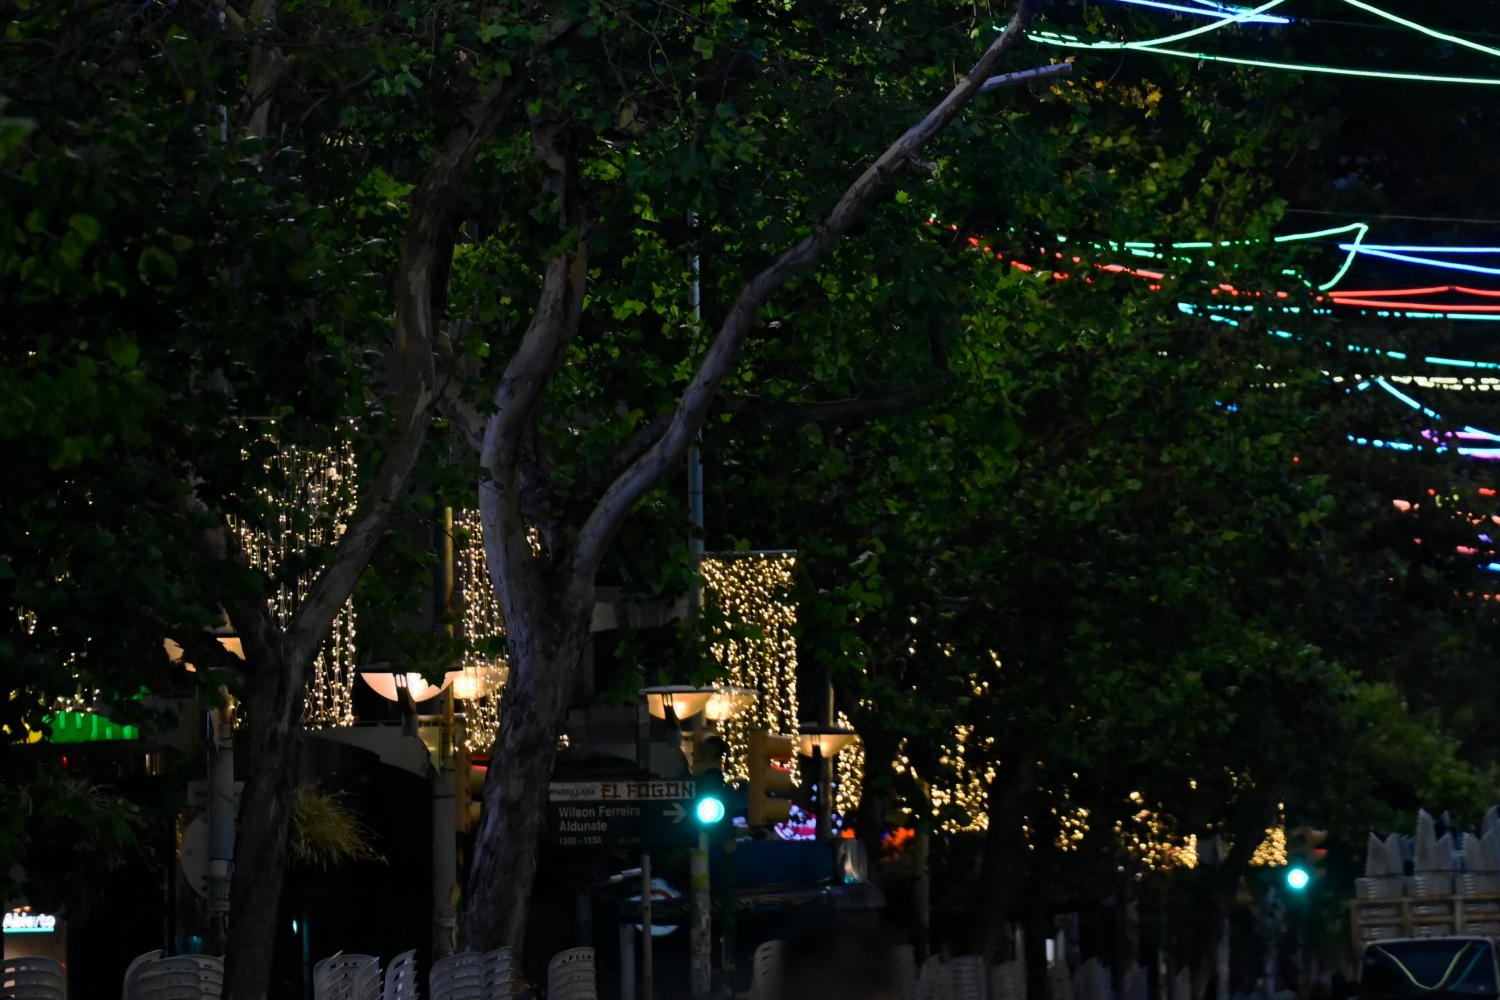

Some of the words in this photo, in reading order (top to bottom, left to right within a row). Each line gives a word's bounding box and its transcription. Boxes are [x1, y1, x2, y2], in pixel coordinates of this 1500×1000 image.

[600, 783, 622, 799] EL
[558, 806, 595, 818] Wilson
[599, 805, 641, 817] Ferreira
[558, 820, 608, 832] Aldunate
[558, 836, 577, 845] 1300
[583, 836, 602, 845] 1350
